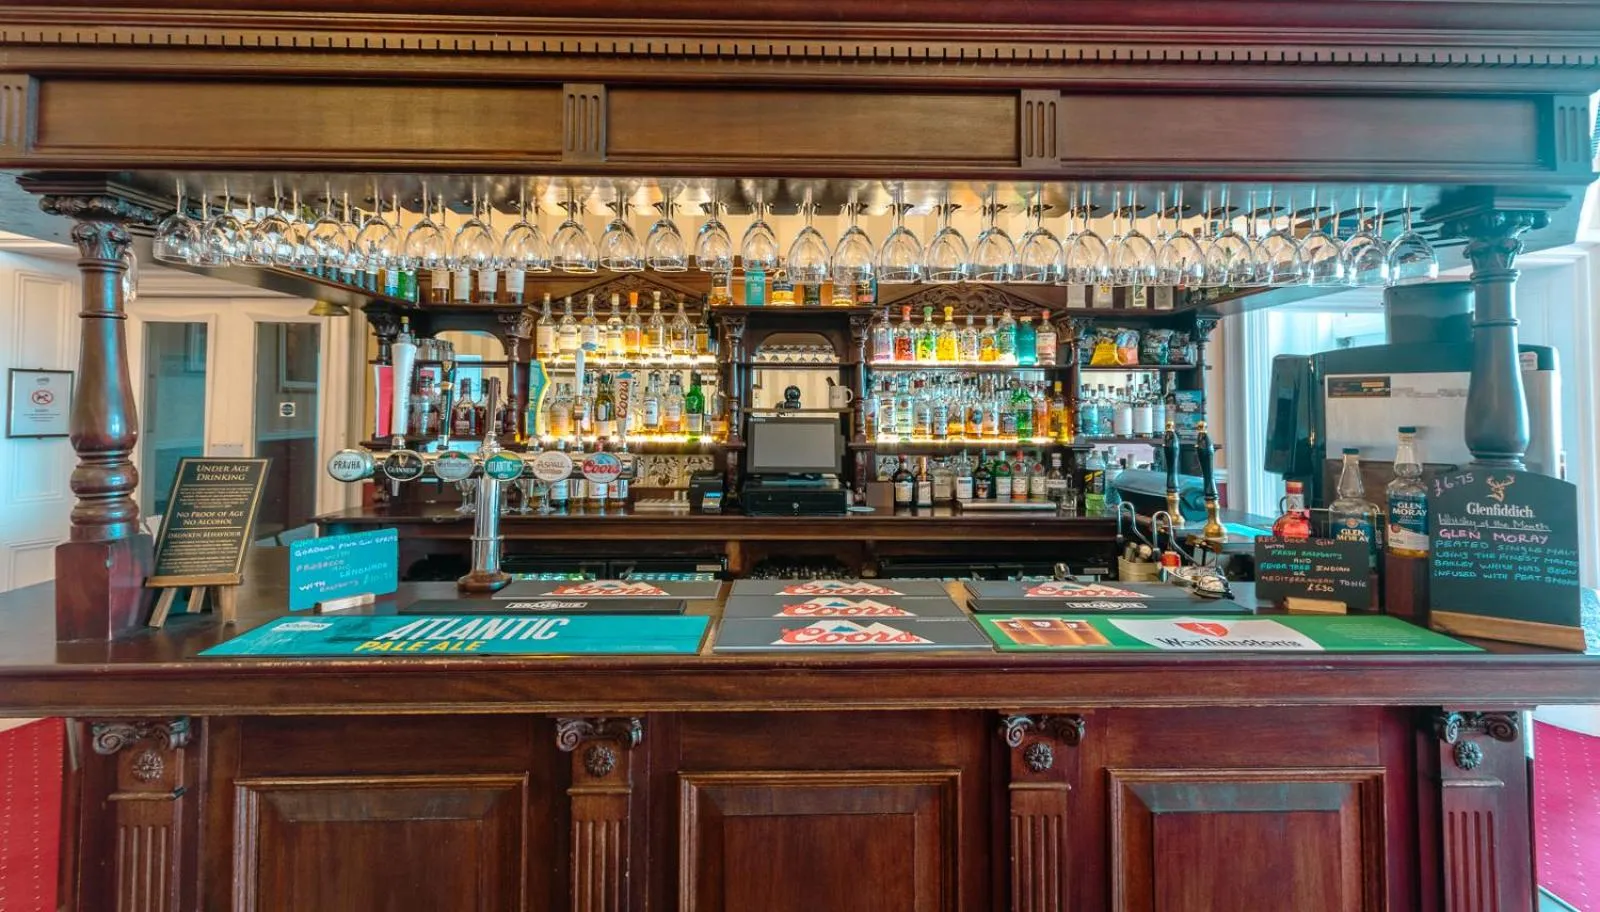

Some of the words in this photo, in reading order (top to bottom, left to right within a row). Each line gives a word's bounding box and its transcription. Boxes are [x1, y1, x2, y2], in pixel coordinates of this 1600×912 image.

[616, 380, 630, 419] Coors
[195, 465, 230, 474] UNDER
[231, 464, 250, 473] AGE
[333, 459, 361, 471] PRAVHA
[487, 461, 513, 473] ATLANTIC
[583, 460, 620, 474] Coors
[196, 474, 246, 482] DRINKING
[1434, 473, 1475, 497] £6.75
[1397, 502, 1422, 510] GLEN
[1466, 502, 1536, 518] Glenfiddich
[176, 511, 190, 519] NO
[1392, 508, 1427, 517] MORAY
[1340, 528, 1365, 537] GLEN
[1439, 529, 1481, 540] GLEN
[1493, 532, 1549, 545] MORAY
[1435, 541, 1489, 549] PEATED
[1514, 573, 1541, 581] PEAT
[298, 580, 326, 592] WITH
[783, 584, 895, 595] Coors
[783, 602, 905, 616] Coors
[373, 617, 570, 641] ATLANTIC
[782, 627, 921, 644] Coors
[353, 640, 426, 652] PALE
[426, 640, 485, 652] ALE
